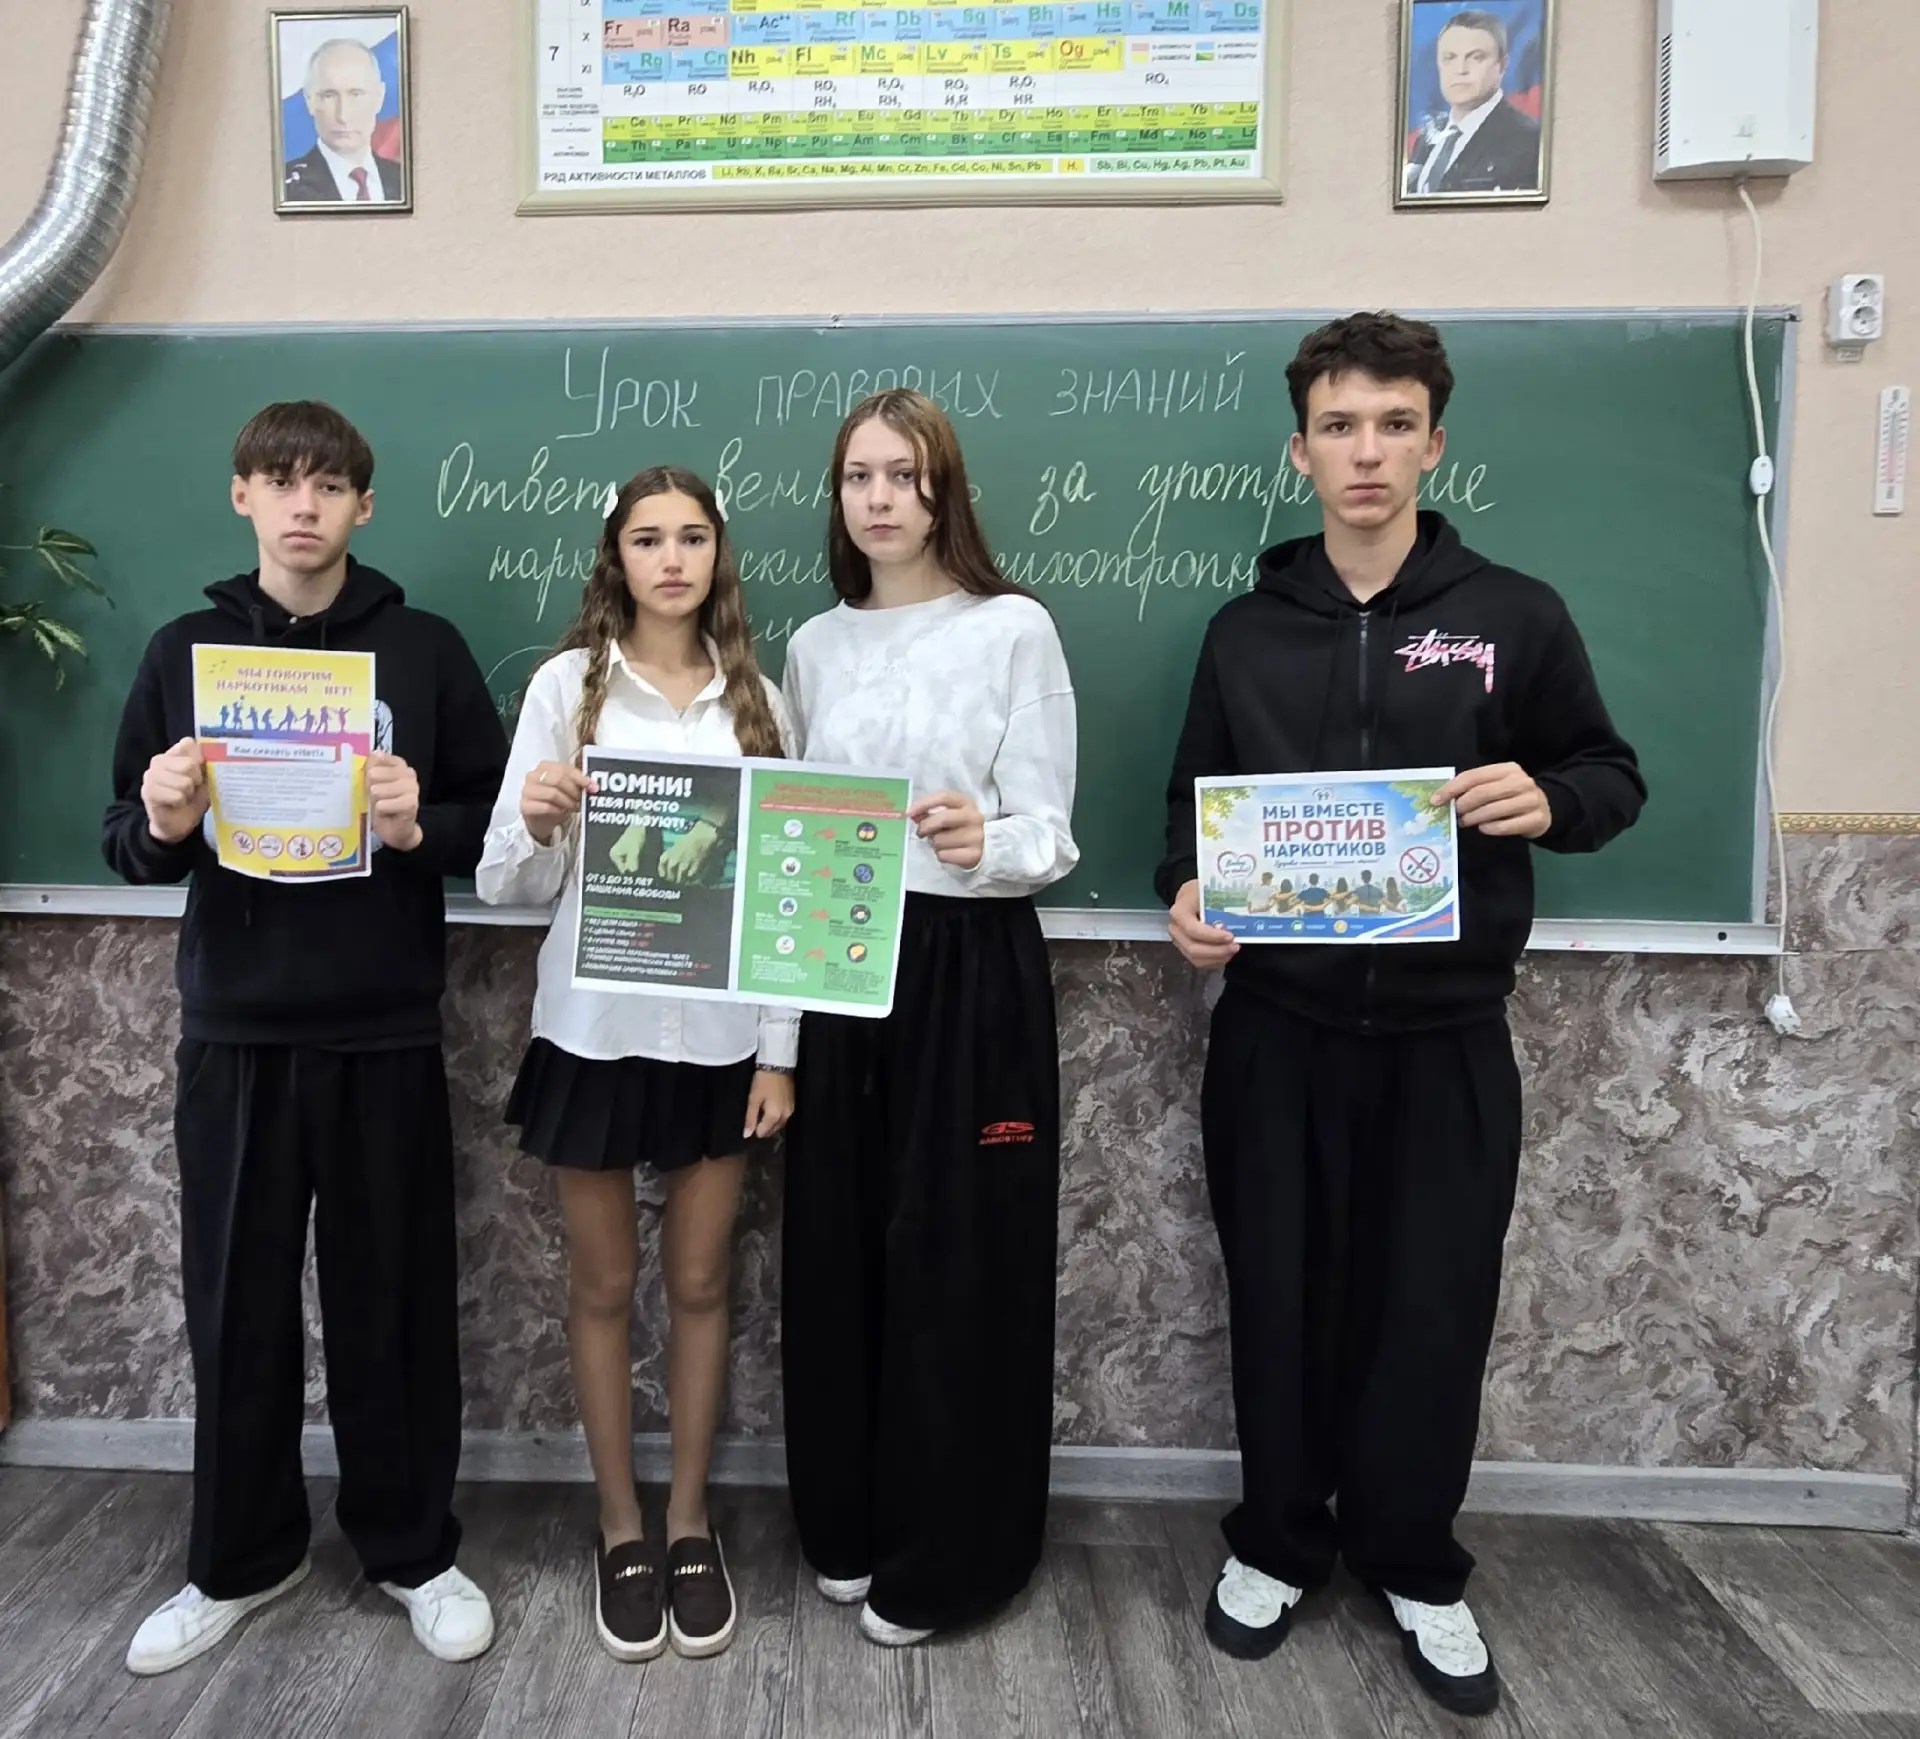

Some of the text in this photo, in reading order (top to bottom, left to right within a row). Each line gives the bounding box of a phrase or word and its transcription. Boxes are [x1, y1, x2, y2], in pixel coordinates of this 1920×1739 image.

[604, 20, 623, 36] Fr
[668, 18, 690, 33] Ra
[835, 11, 856, 26] Rf
[896, 10, 921, 26] Db
[963, 8, 986, 25] Sg
[1028, 6, 1053, 22] Bh
[1097, 3, 1121, 18] Hs
[1167, 1, 1189, 17] Mt
[1234, 2, 1258, 17] Ds
[549, 45, 560, 62] 7
[704, 51, 728, 66] Cn
[731, 49, 755, 65] Nh
[796, 47, 811, 62] Fl
[861, 45, 886, 61] Mc
[926, 44, 948, 61] Lv
[991, 43, 1012, 59] Ts
[1060, 40, 1084, 58] Og
[630, 116, 646, 128] Ce
[678, 115, 692, 126] Pr
[762, 113, 782, 124] Pm
[808, 112, 828, 123] Sm
[858, 110, 875, 121] Eu
[903, 109, 921, 120] Gd
[952, 110, 968, 121] Tb
[999, 109, 1016, 122] Dy
[1097, 106, 1112, 117] Er
[1140, 106, 1159, 116] Tm
[1190, 103, 1207, 115] Yb
[1240, 102, 1257, 113] Lu
[631, 140, 646, 151] Th
[676, 139, 691, 149] Pa
[765, 137, 782, 150] Np
[812, 136, 828, 147] Pu
[852, 135, 874, 146] Am
[900, 133, 921, 145] Cm
[952, 134, 967, 144] Bk
[1001, 132, 1016, 143] Cf
[1090, 130, 1110, 141] Fm
[1140, 129, 1158, 140] Md
[1189, 128, 1206, 140] No
[1242, 126, 1256, 137] Lr
[544, 168, 707, 184] РЯД АКТИВНОСТИ МЕТАЛЛОВ
[1029, 461, 1097, 536] за
[238, 667, 333, 682] МЫ ГОВОРИМ
[216, 680, 353, 697] НАРКОТИКАМ НЕТ!
[590, 770, 693, 798] ПОМНИ!
[588, 796, 680, 813] ТЕБЯ ПРОСТО
[1262, 802, 1385, 820] МЫ ВМЕСТЕ
[1263, 818, 1386, 842] ПРОТИВ
[1263, 842, 1386, 858] НАРКОТИКОВ
[585, 872, 600, 883] ОТ
[606, 875, 622, 885] ДО
[634, 877, 654, 887] ЛЕТ
[585, 883, 681, 900] ЛИШЕНИЯ СВОБОДЫ
